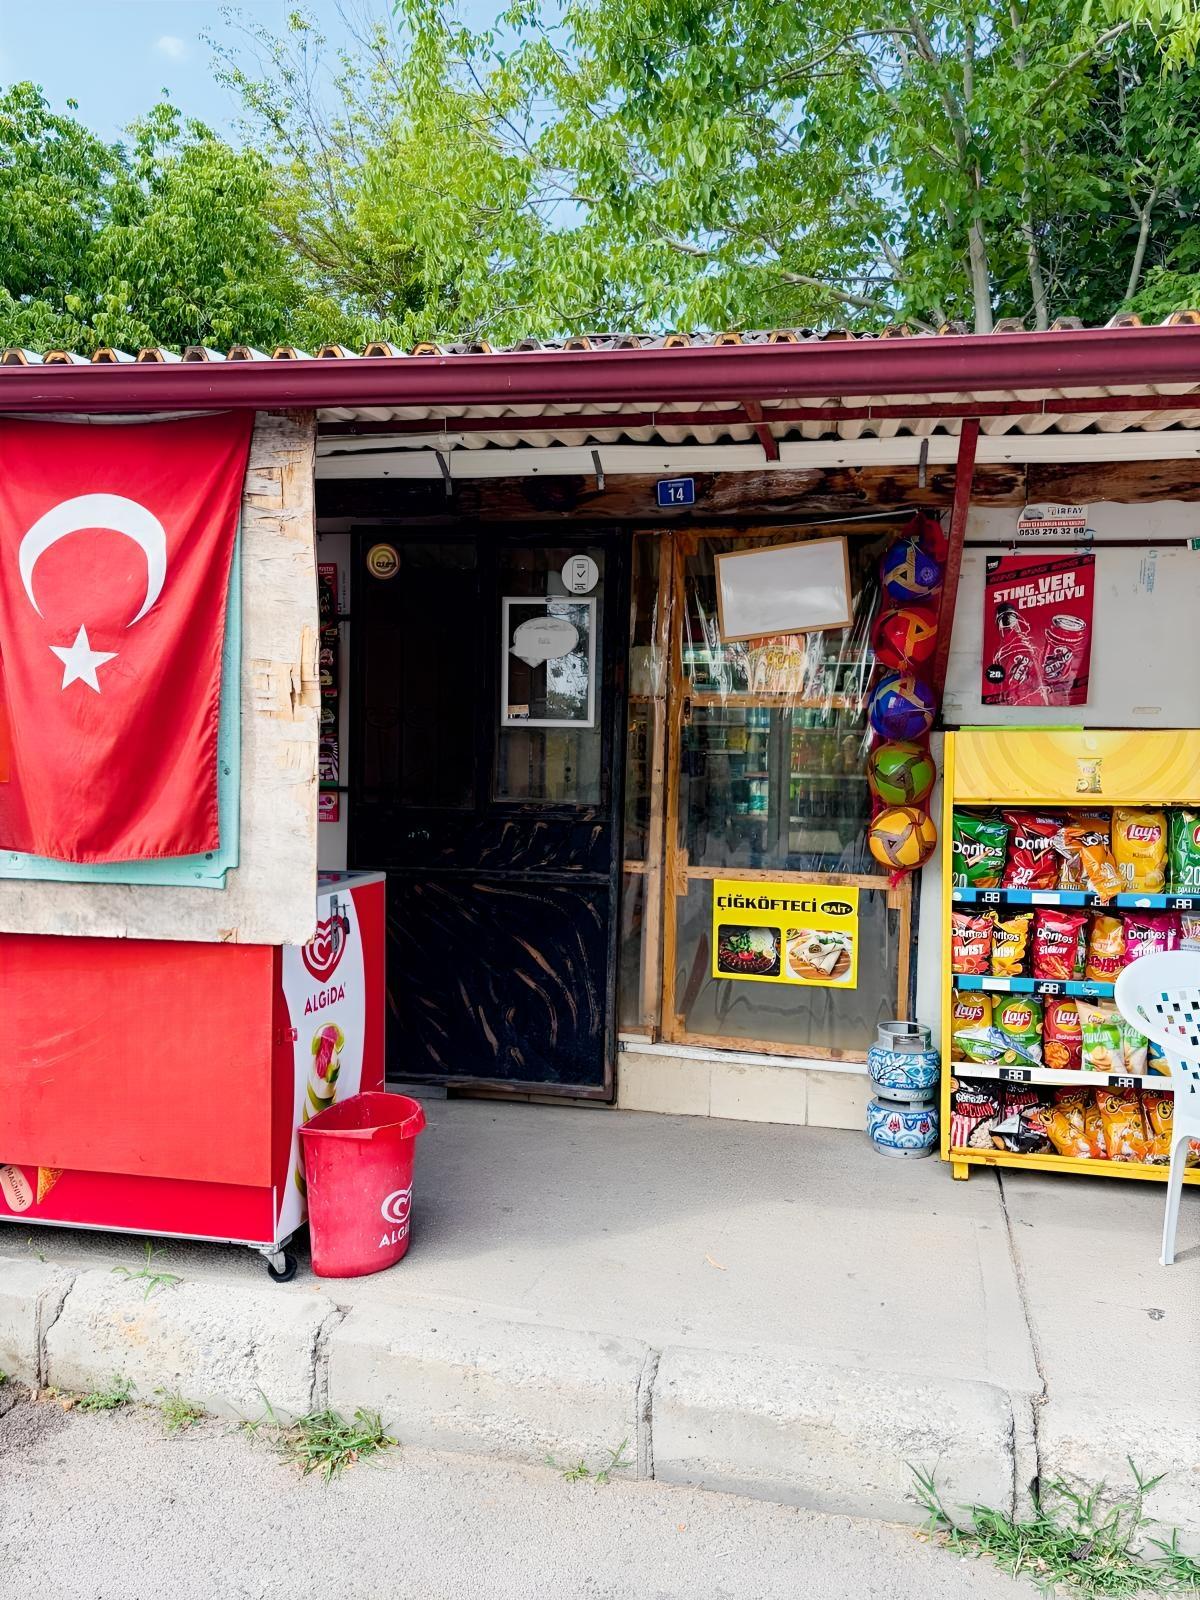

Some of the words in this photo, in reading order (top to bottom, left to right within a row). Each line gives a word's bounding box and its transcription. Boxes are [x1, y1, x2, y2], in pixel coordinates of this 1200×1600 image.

[668, 487, 684, 502] 14
[1018, 585, 1085, 610] COŞKUYU
[1128, 824, 1160, 842] Lay's
[952, 840, 1003, 857] Doritos
[717, 893, 817, 913] ÇİĞKÖFTECİ
[993, 930, 1020, 942] oritos
[1037, 928, 1073, 943] Doritos
[1128, 930, 1166, 940] Doritos
[1003, 1010, 1030, 1026] Lay's
